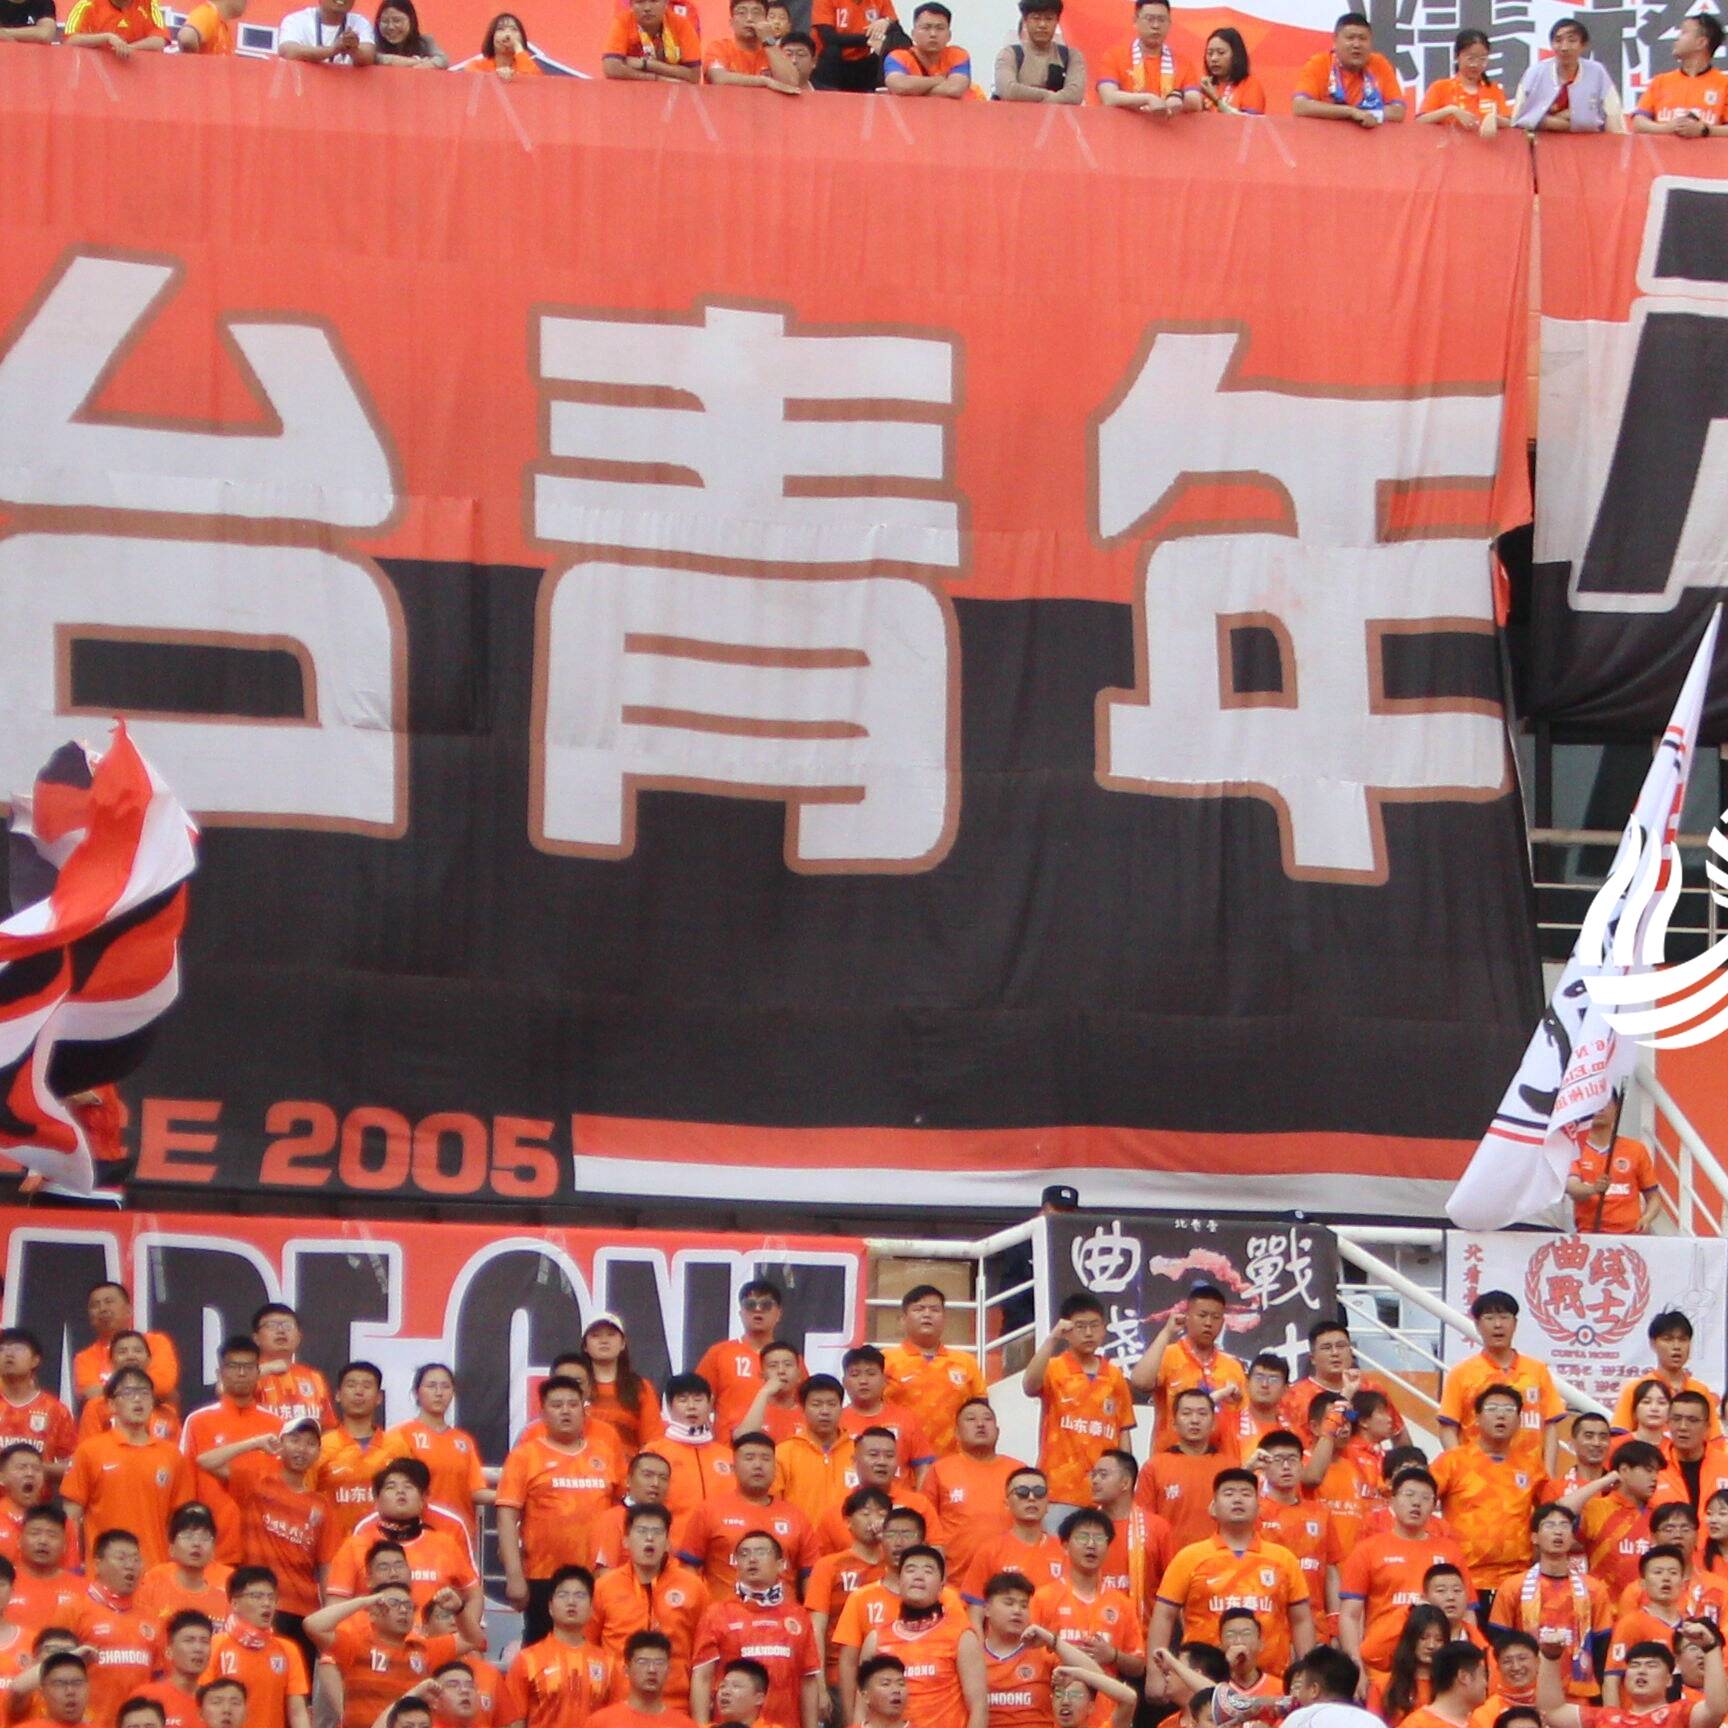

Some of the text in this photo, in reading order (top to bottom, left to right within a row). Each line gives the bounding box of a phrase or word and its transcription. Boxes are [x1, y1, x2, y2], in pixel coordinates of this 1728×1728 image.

[259, 1101, 560, 1200] 2005
[735, 1355, 751, 1377] 12
[263, 1404, 322, 1420] 山东泰山
[1059, 1416, 1115, 1439] 山东泰山
[410, 1432, 429, 1450] 12
[551, 1476, 606, 1489] SHANDONG
[840, 1571, 858, 1591] 12
[865, 1602, 885, 1624] 12
[1208, 1594, 1274, 1614] 山东泰山
[369, 1649, 387, 1671] 12
[740, 1645, 791, 1659] SHANDONG
[220, 1652, 238, 1674] 12
